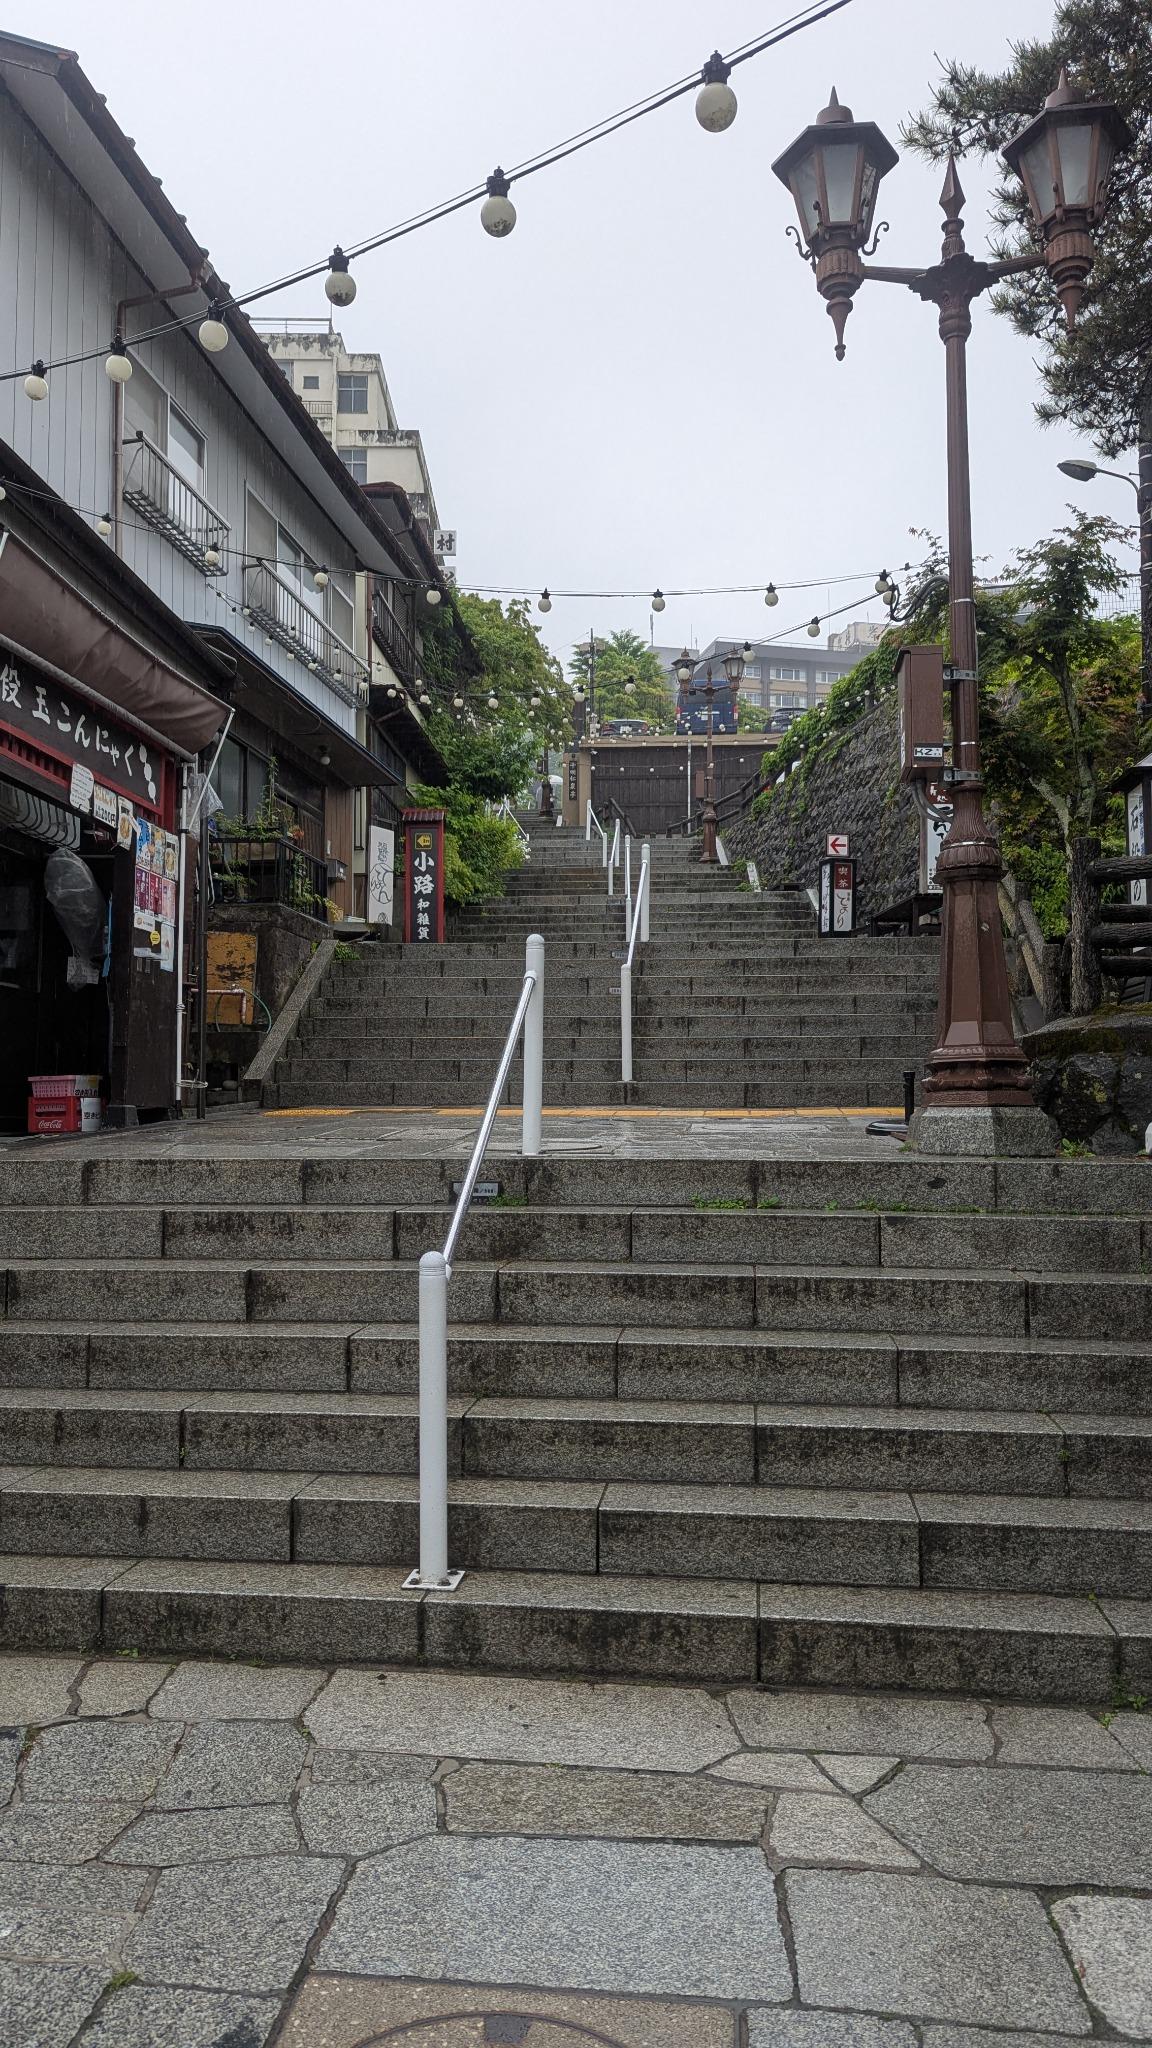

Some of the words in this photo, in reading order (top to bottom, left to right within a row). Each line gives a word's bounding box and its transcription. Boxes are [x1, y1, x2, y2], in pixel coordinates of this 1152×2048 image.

[414, 851, 435, 895] 小路
[417, 898, 431, 940] 和雑貨
[38, 1119, 63, 1129] Coca-Cola
